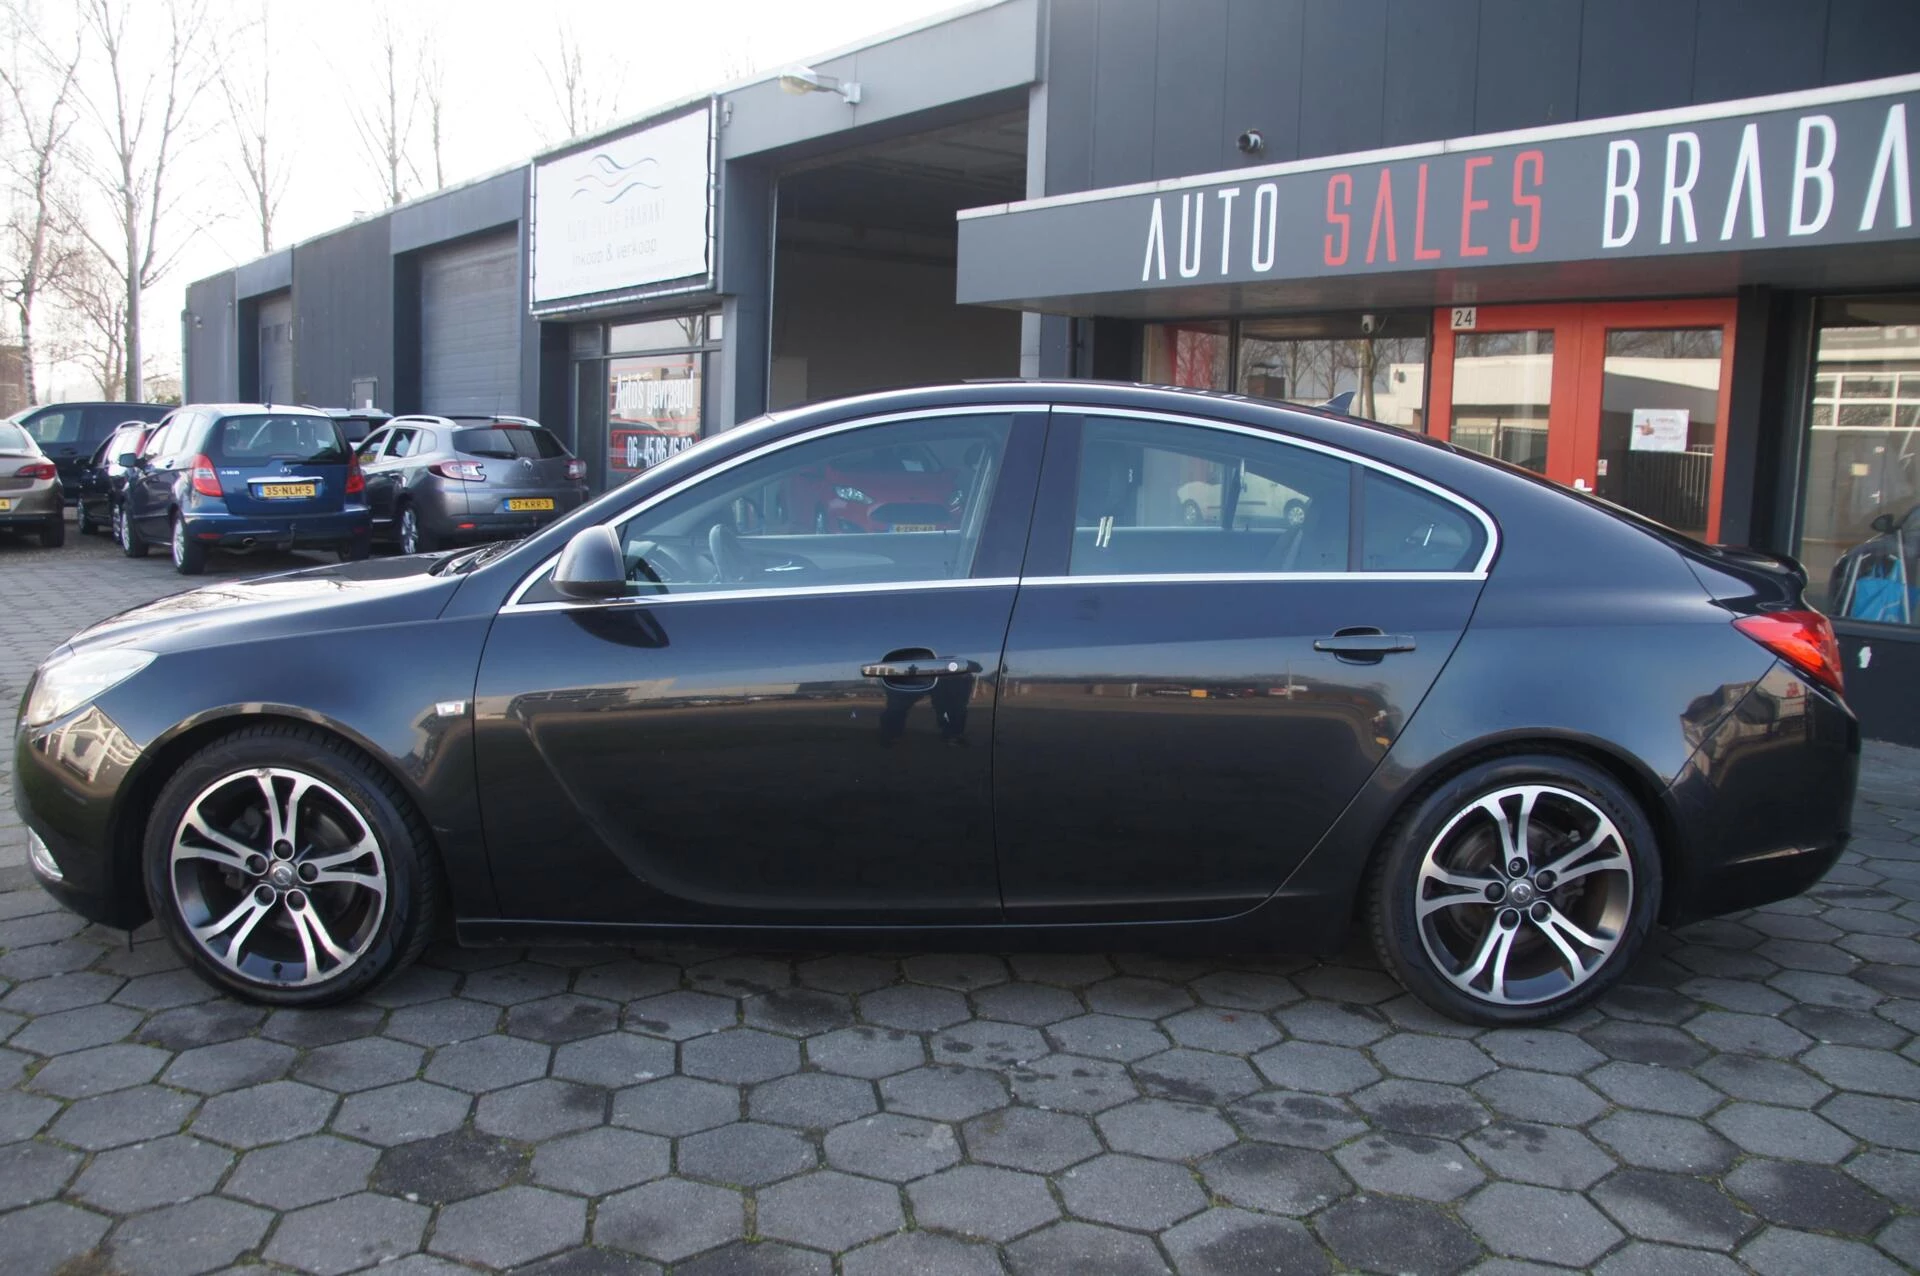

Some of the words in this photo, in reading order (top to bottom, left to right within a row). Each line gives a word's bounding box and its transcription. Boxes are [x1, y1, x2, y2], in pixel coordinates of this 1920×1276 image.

[1142, 183, 1278, 281] AUTO
[1324, 149, 1544, 266] SALES
[1602, 103, 1912, 248] BRABA
[1455, 310, 1472, 326] 24
[647, 370, 694, 415] gevraagd
[627, 436, 638, 468] 06
[265, 484, 313, 496] 35-NLH-5
